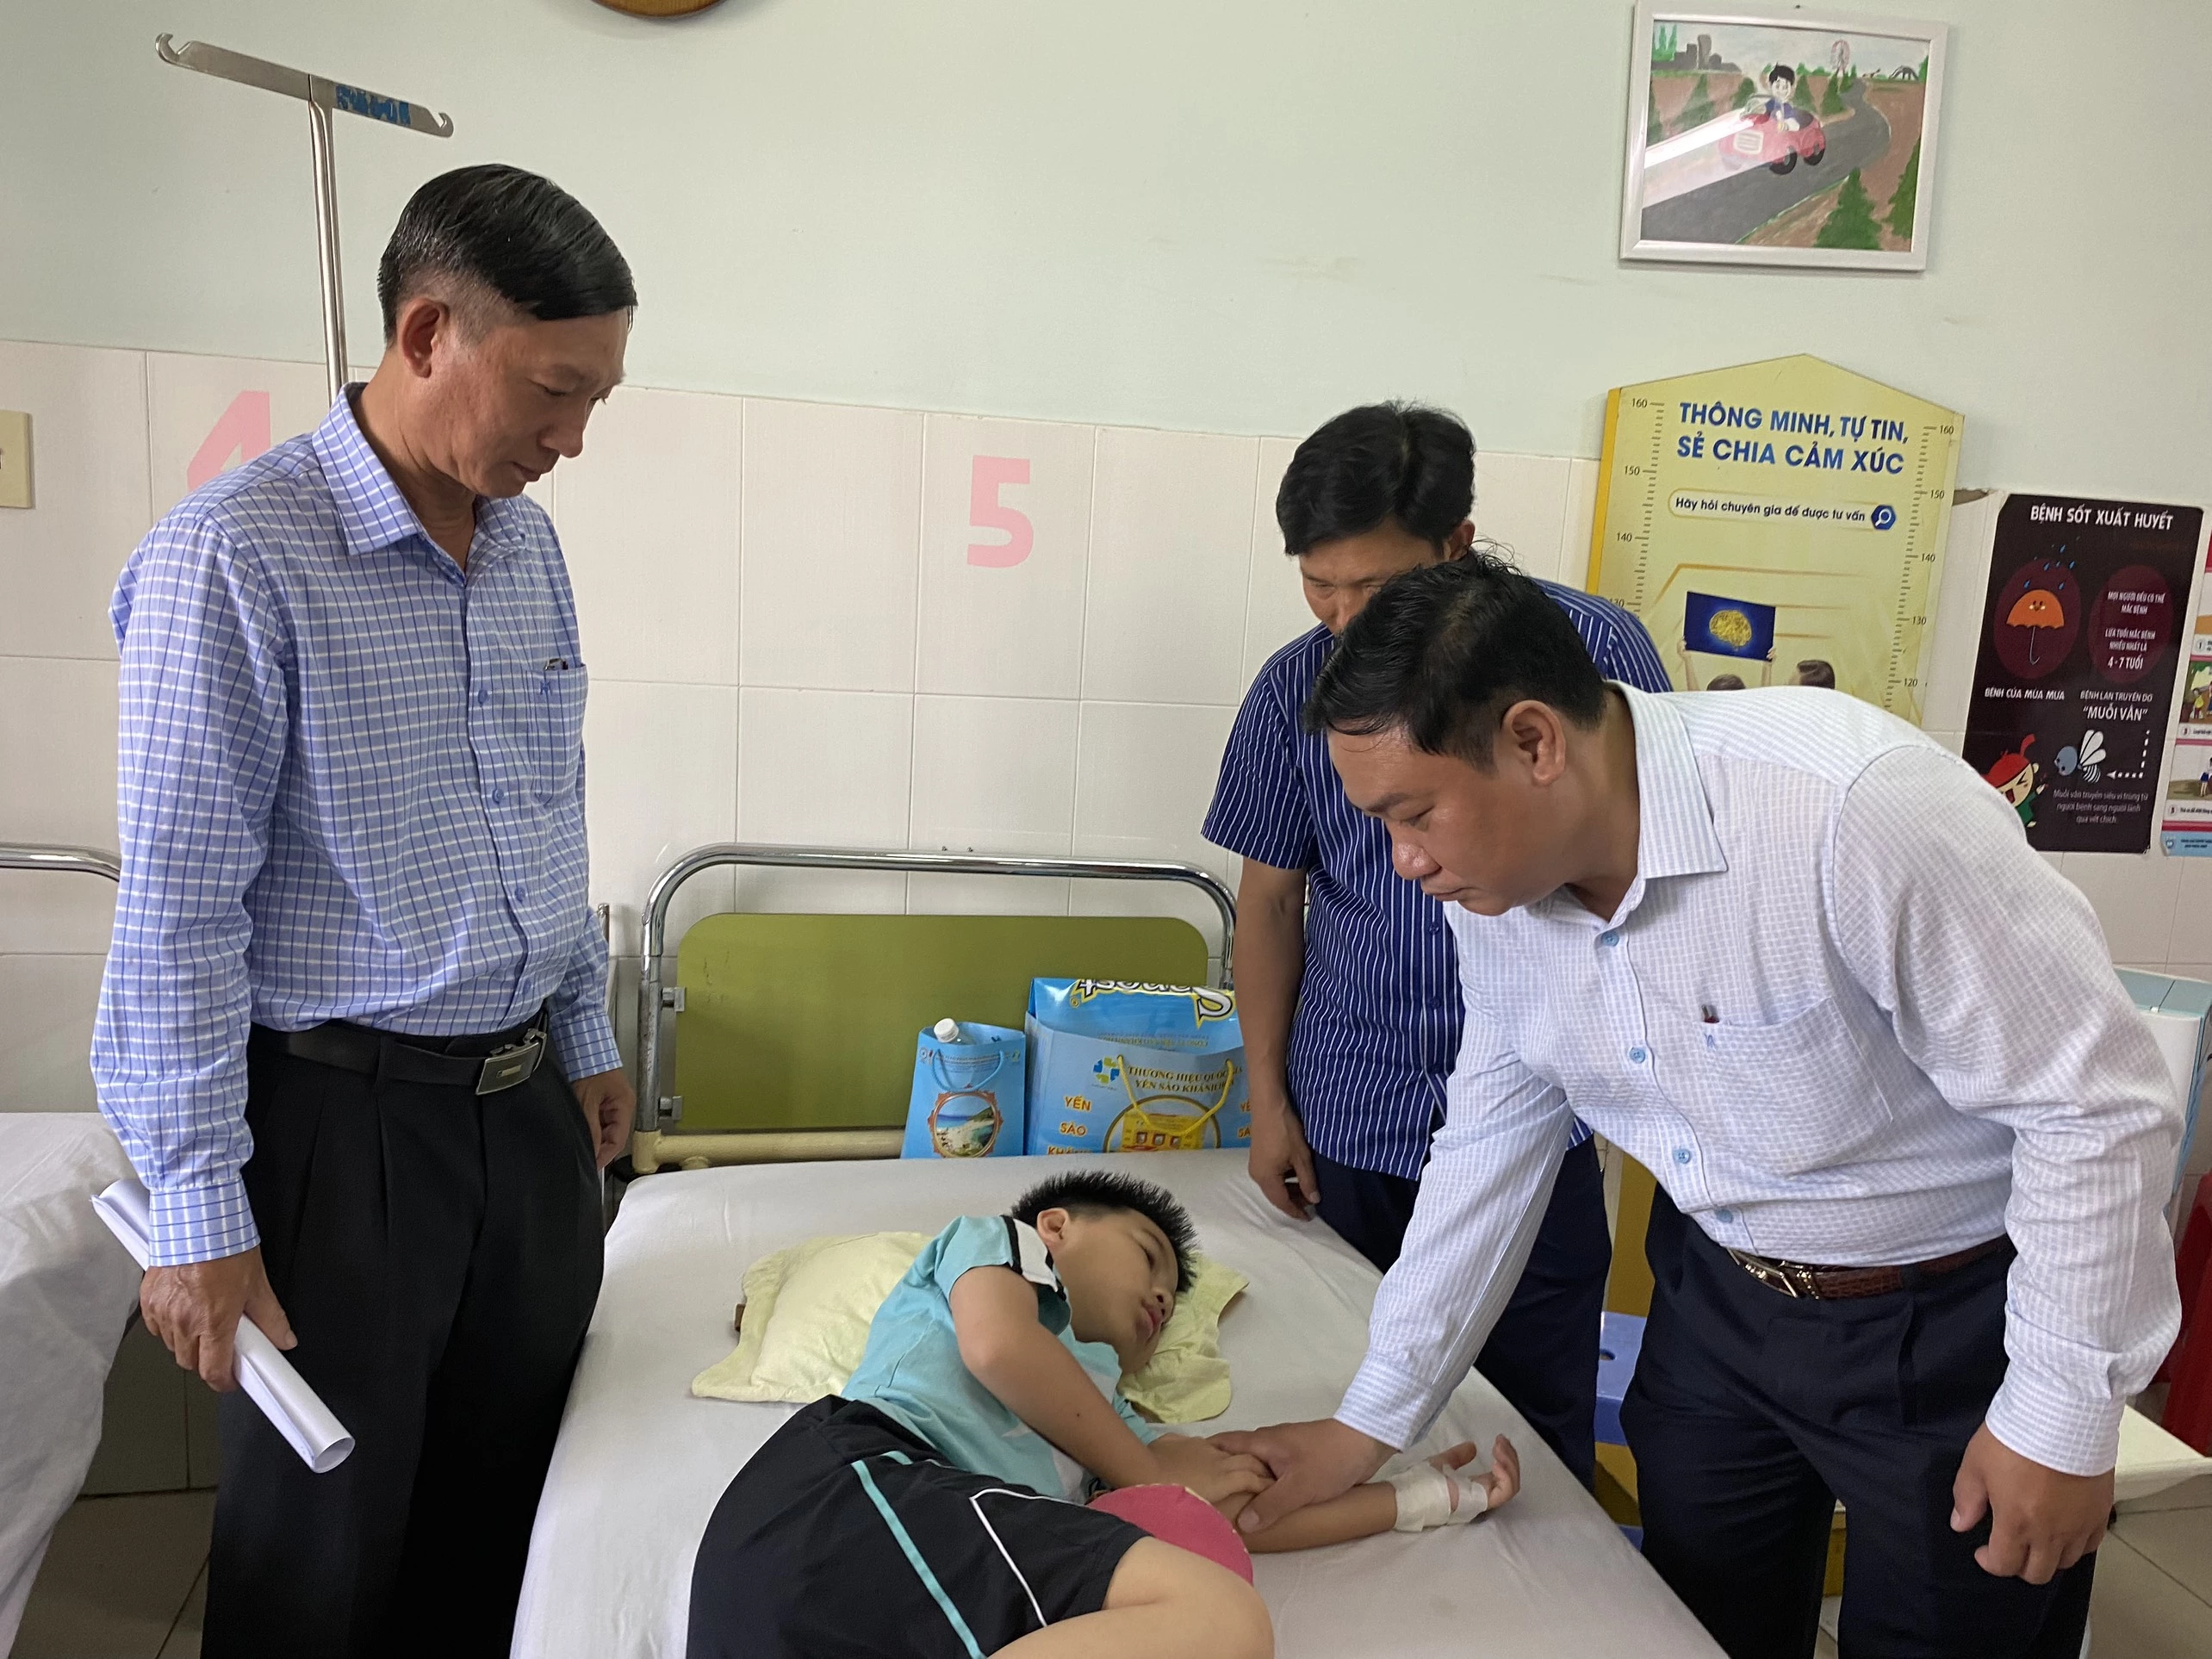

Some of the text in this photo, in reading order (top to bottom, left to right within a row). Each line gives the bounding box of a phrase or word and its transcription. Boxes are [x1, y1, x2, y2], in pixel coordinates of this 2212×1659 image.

[1631, 398, 1648, 409] 160
[1679, 401, 1909, 443] THÔNG MINH, TỰ TIN,
[1938, 424, 1954, 435] 160
[1677, 431, 1904, 475] SẺ CHIA CẢM XÚC
[1624, 465, 1640, 476] 150
[1929, 489, 1945, 500] 150
[967, 455, 1034, 569] 5
[1675, 497, 1699, 512] Hãy
[1700, 499, 1718, 511] hỏi
[1721, 500, 1761, 514] chuyên
[1763, 505, 1781, 518] gia
[1802, 507, 1829, 520] được
[1845, 510, 1865, 521] vấn
[2029, 503, 2173, 531] BỆNH SỐT XUẤT HUYẾT
[1616, 532, 1633, 543] 140
[1921, 553, 1936, 563] 140
[1911, 615, 1927, 625] 130
[2125, 655, 2144, 670] TUỔI
[1904, 677, 1918, 687] 120
[2099, 691, 2114, 701] LAN
[1128, 1065, 1174, 1080] THƯƠNG
[1135, 1078, 1155, 1090] YẾN
[1159, 1082, 1180, 1092] SÀO
[1064, 1095, 1091, 1112] YẾN
[1059, 1121, 1087, 1136] SÀO
